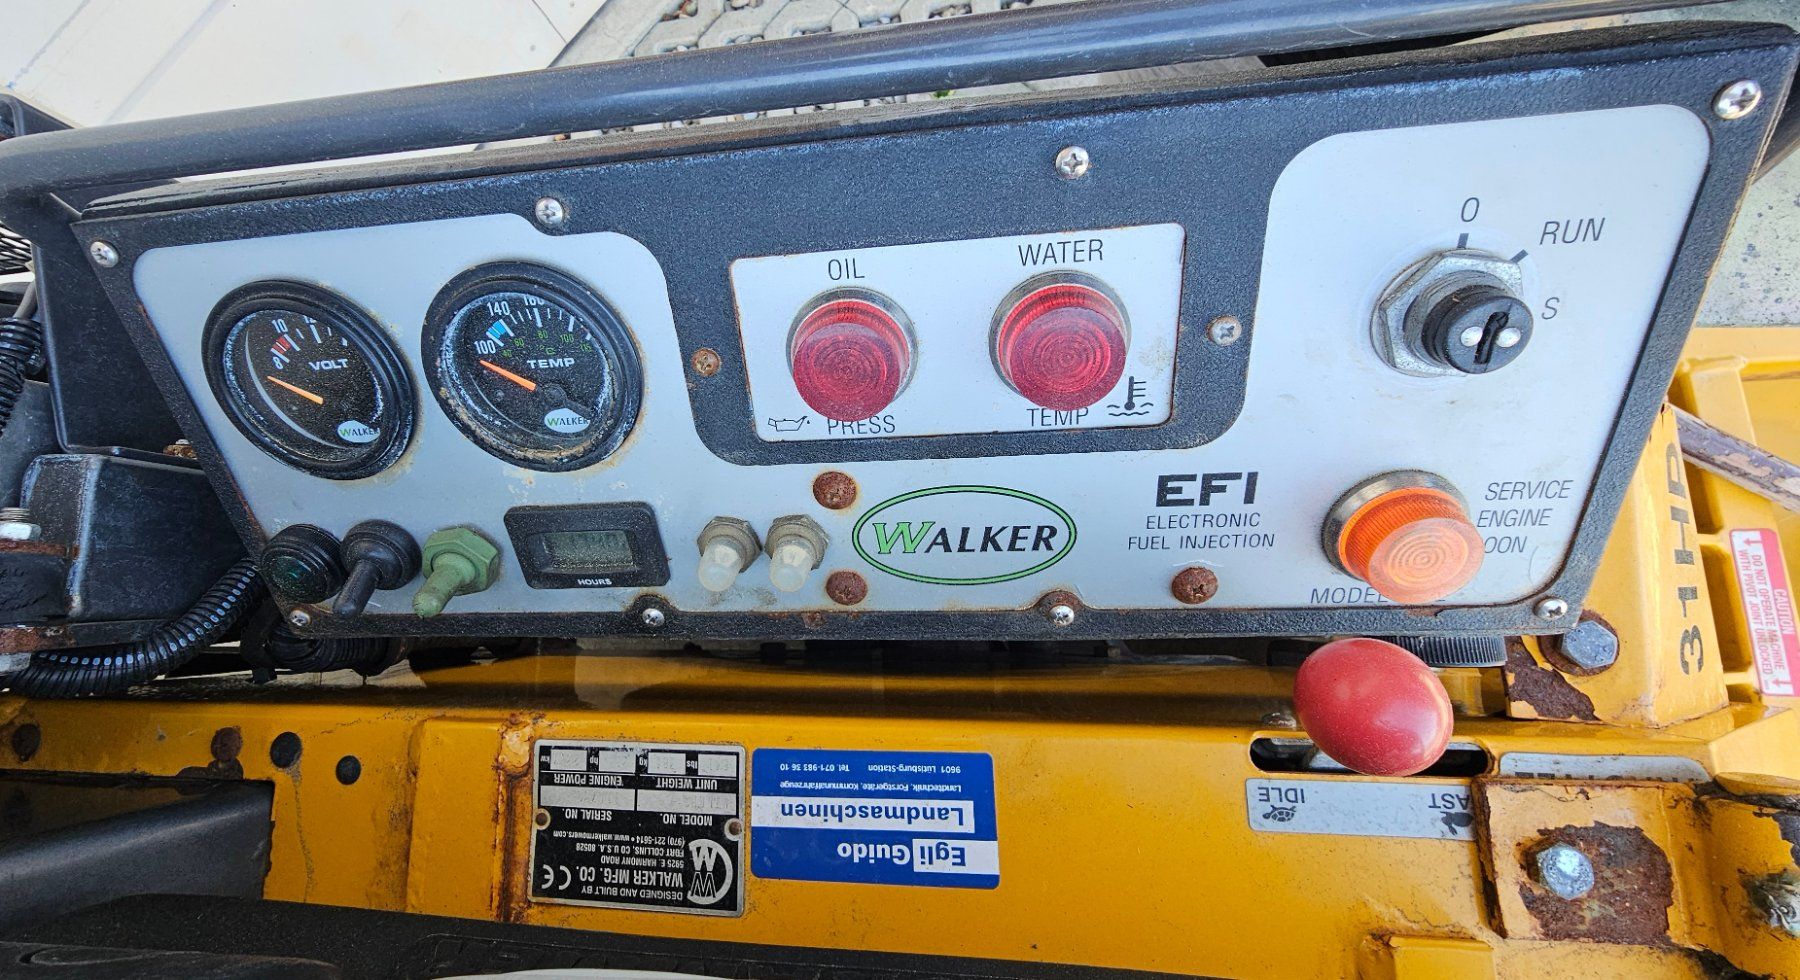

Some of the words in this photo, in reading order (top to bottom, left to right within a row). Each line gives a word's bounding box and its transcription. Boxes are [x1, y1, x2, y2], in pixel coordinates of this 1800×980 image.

[1539, 217, 1605, 245] RUN
[1018, 239, 1104, 267] WATER
[827, 258, 865, 281] OIL
[486, 300, 511, 317] 140
[1541, 297, 1560, 320] S
[272, 319, 288, 334] 10
[474, 339, 497, 355] 100
[272, 356, 284, 369] 8
[308, 358, 348, 371] VOLT
[527, 357, 575, 369] TEMP
[1026, 406, 1089, 427] TEMP
[827, 414, 896, 435] PRESS
[1155, 471, 1259, 507] EFI
[1485, 480, 1573, 500] SERVICE
[1146, 512, 1261, 530] ELECTRONIC
[1477, 508, 1553, 527] ENGINE
[871, 520, 1058, 556] WALKER
[1127, 534, 1171, 551] FUEL
[1180, 533, 1275, 549] INJECTION
[1484, 536, 1527, 553] OON
[1738, 550, 1751, 571] WITH
[1752, 554, 1763, 567] DO
[577, 578, 613, 586] HOURS
[1755, 569, 1767, 586] NOT
[1743, 573, 1758, 598] PIVOT
[1311, 587, 1388, 604] MODEL
[1749, 601, 1763, 626] JOINT
[1759, 588, 1775, 627] OPERATE
[1774, 588, 1795, 634] CAUTION
[1755, 628, 1773, 674] UNLOCKED
[1768, 629, 1785, 670] MACHINE
[779, 763, 790, 771] 10
[791, 763, 801, 772] 36
[804, 763, 835, 772] 071-983
[868, 763, 936, 774] Lütisburg-Station
[554, 774, 586, 785] POWER
[588, 775, 622, 786] ENGINE
[656, 777, 692, 789] WEIGHT
[695, 779, 718, 790] UNIT
[780, 780, 858, 791] Kommunalfahrzeuge
[913, 782, 962, 792] Landtechnik,
[1258, 787, 1305, 803] IDLE
[1428, 793, 1470, 810] AST
[562, 808, 578, 819] NO.
[581, 809, 613, 821] SERIAL
[660, 813, 676, 825] NO.
[680, 814, 713, 826] MODEL
[781, 803, 964, 826] Landmaschinen
[553, 830, 630, 842] www.walkermowers.com
[636, 835, 666, 846] 221-5614
[667, 836, 685, 849] (970)
[575, 842, 596, 852] 80528
[620, 845, 631, 854] CO
[632, 845, 664, 856] COLLINS,
[666, 848, 685, 857] FORT
[837, 842, 910, 865] Guido
[600, 855, 620, 865] ROAD
[920, 842, 966, 867] Egli
[621, 856, 657, 867] HARMONY
[658, 858, 666, 867] E.
[667, 859, 684, 868] 5925
[576, 866, 596, 882] CO.
[599, 867, 630, 884] MFG.
[633, 869, 684, 888] WALKER
[581, 885, 593, 894] BY
[595, 886, 618, 896] BUILT
[619, 887, 637, 897] AND
[639, 888, 683, 900] DESIGNED
